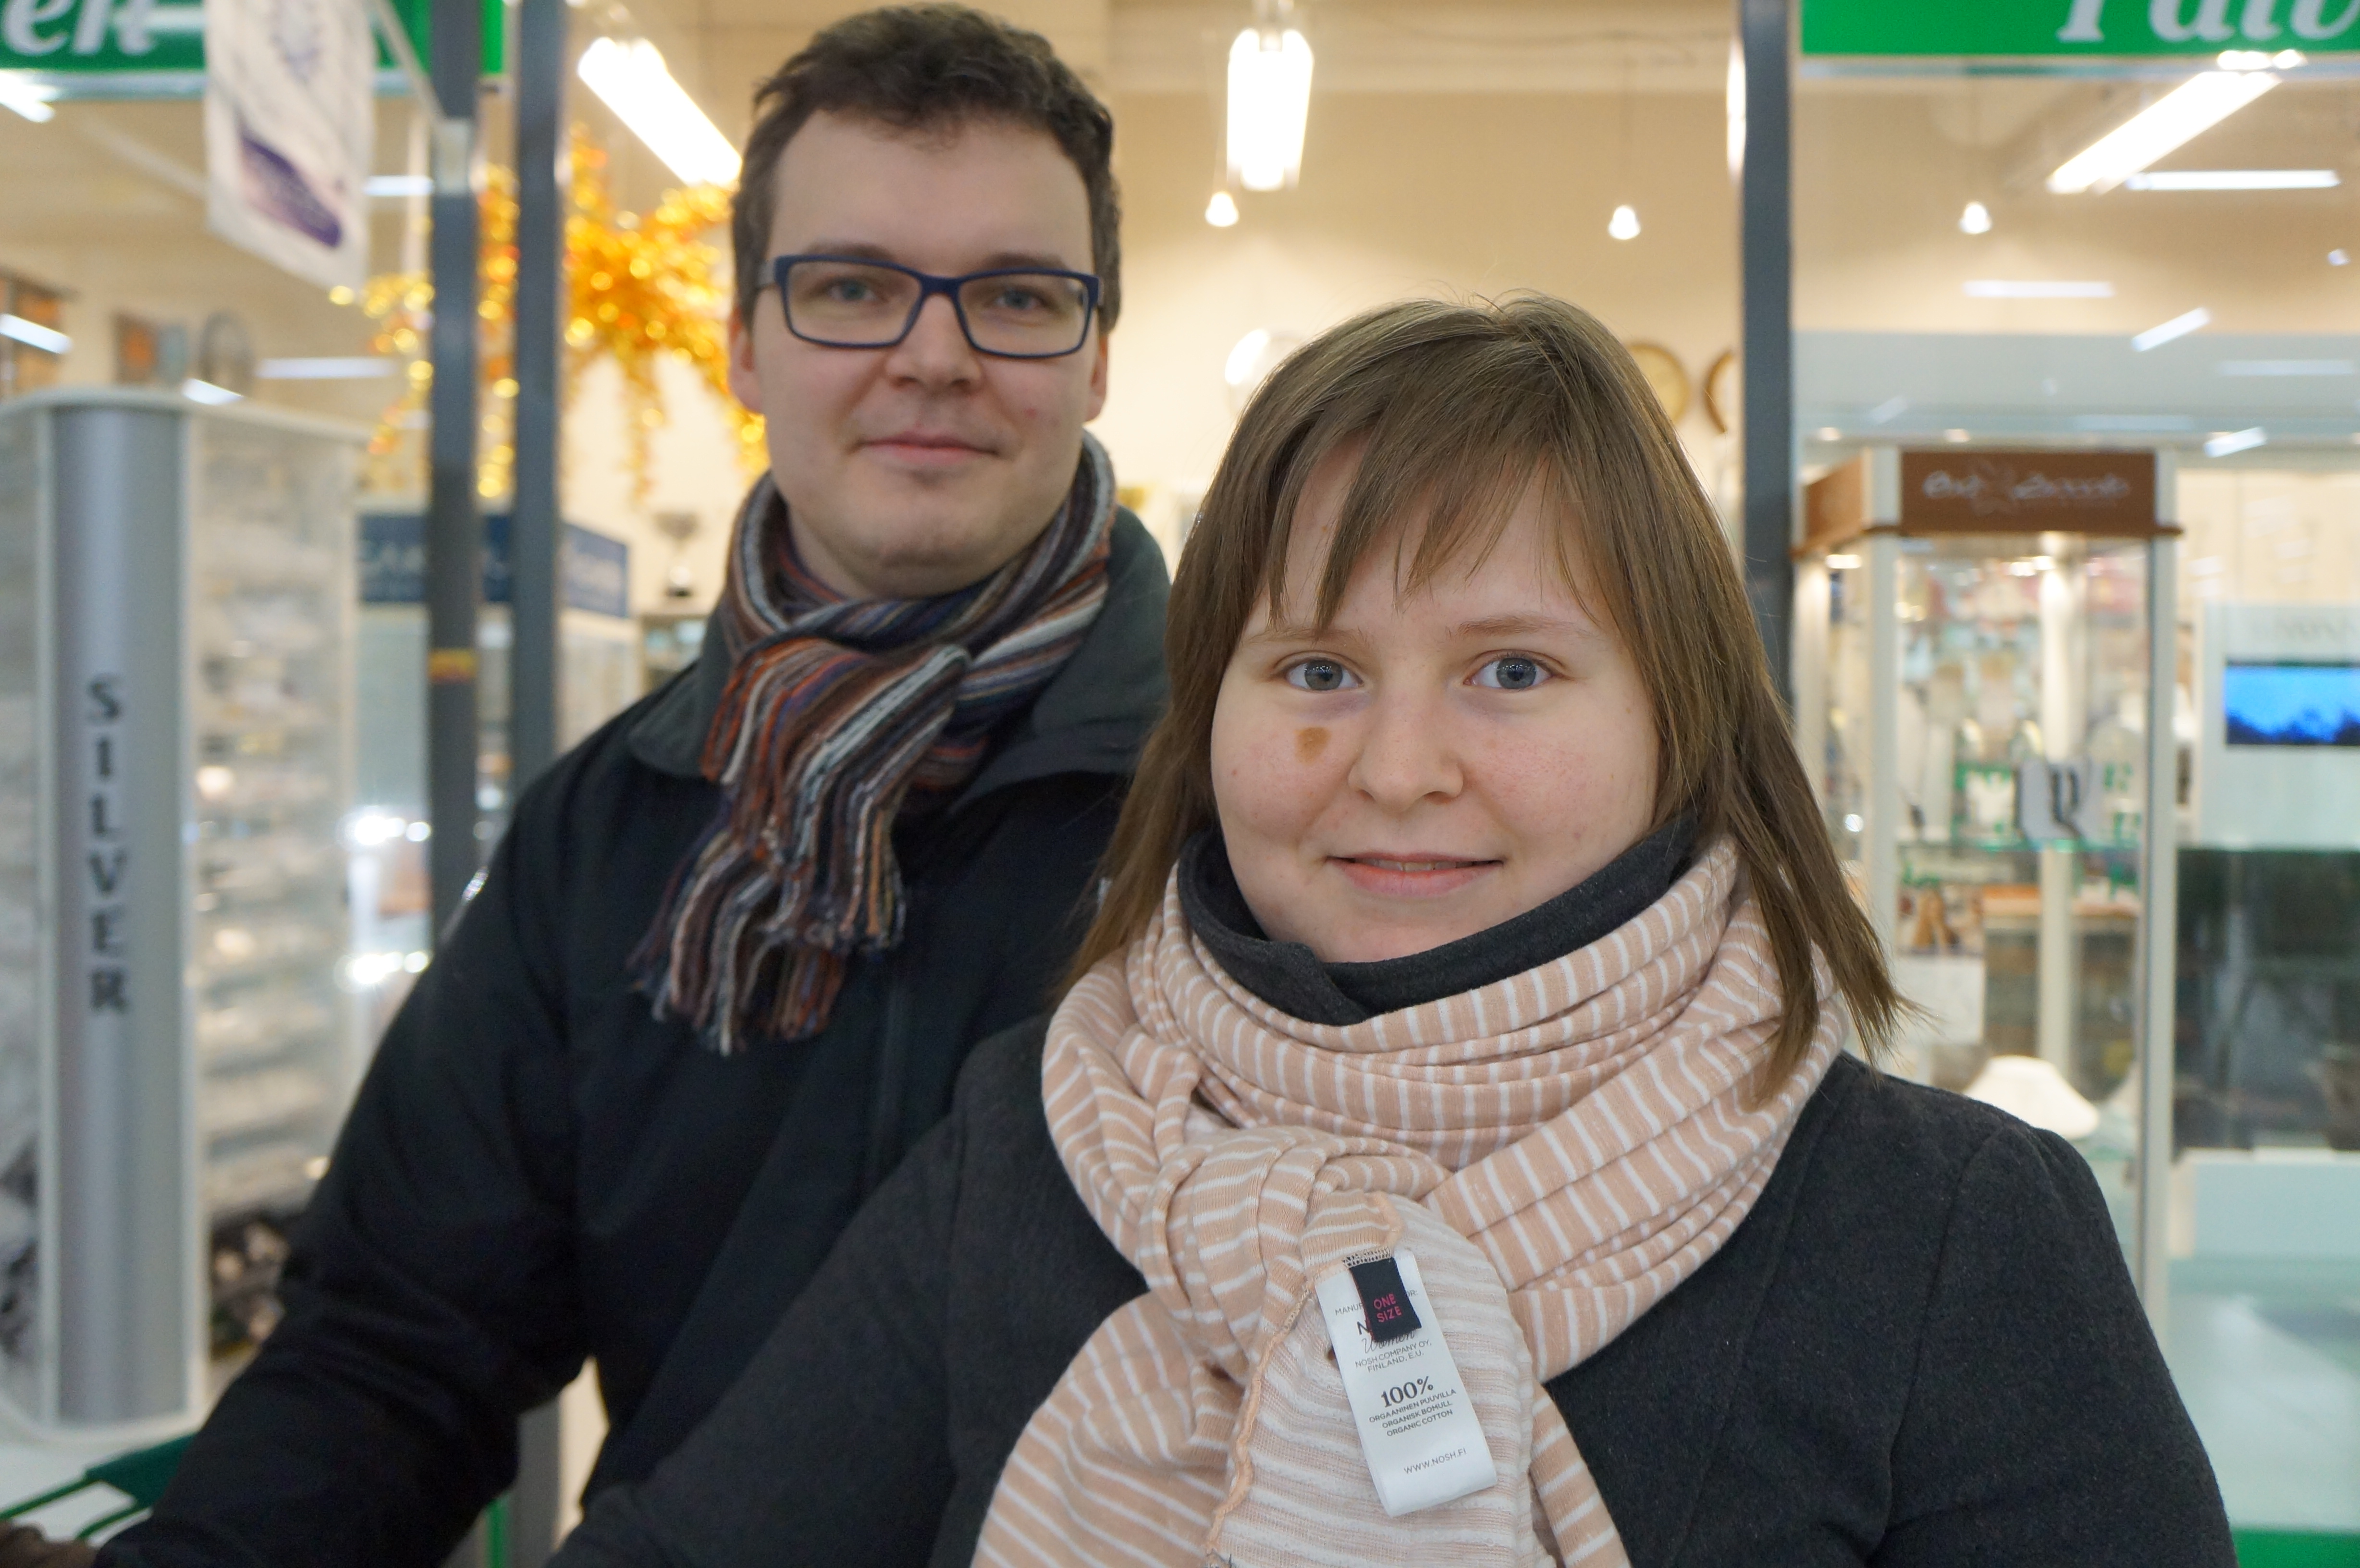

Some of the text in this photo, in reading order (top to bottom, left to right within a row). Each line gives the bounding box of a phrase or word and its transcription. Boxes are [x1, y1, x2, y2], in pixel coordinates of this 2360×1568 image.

[87, 680, 127, 1015] SILVER
[1374, 1293, 1396, 1309] ONE
[1377, 1306, 1402, 1323] SIZE
[1355, 1357, 1377, 1368] NOSH
[1378, 1344, 1417, 1360] COMPANY
[1367, 1355, 1408, 1372] FINLAND,
[1369, 1389, 1456, 1422] ORGAANINEN PUUVILLA
[1381, 1376, 1434, 1408] 100%
[1382, 1400, 1452, 1428] ORGANISK BOMULL
[1387, 1409, 1453, 1436] ORGANIC COTTON
